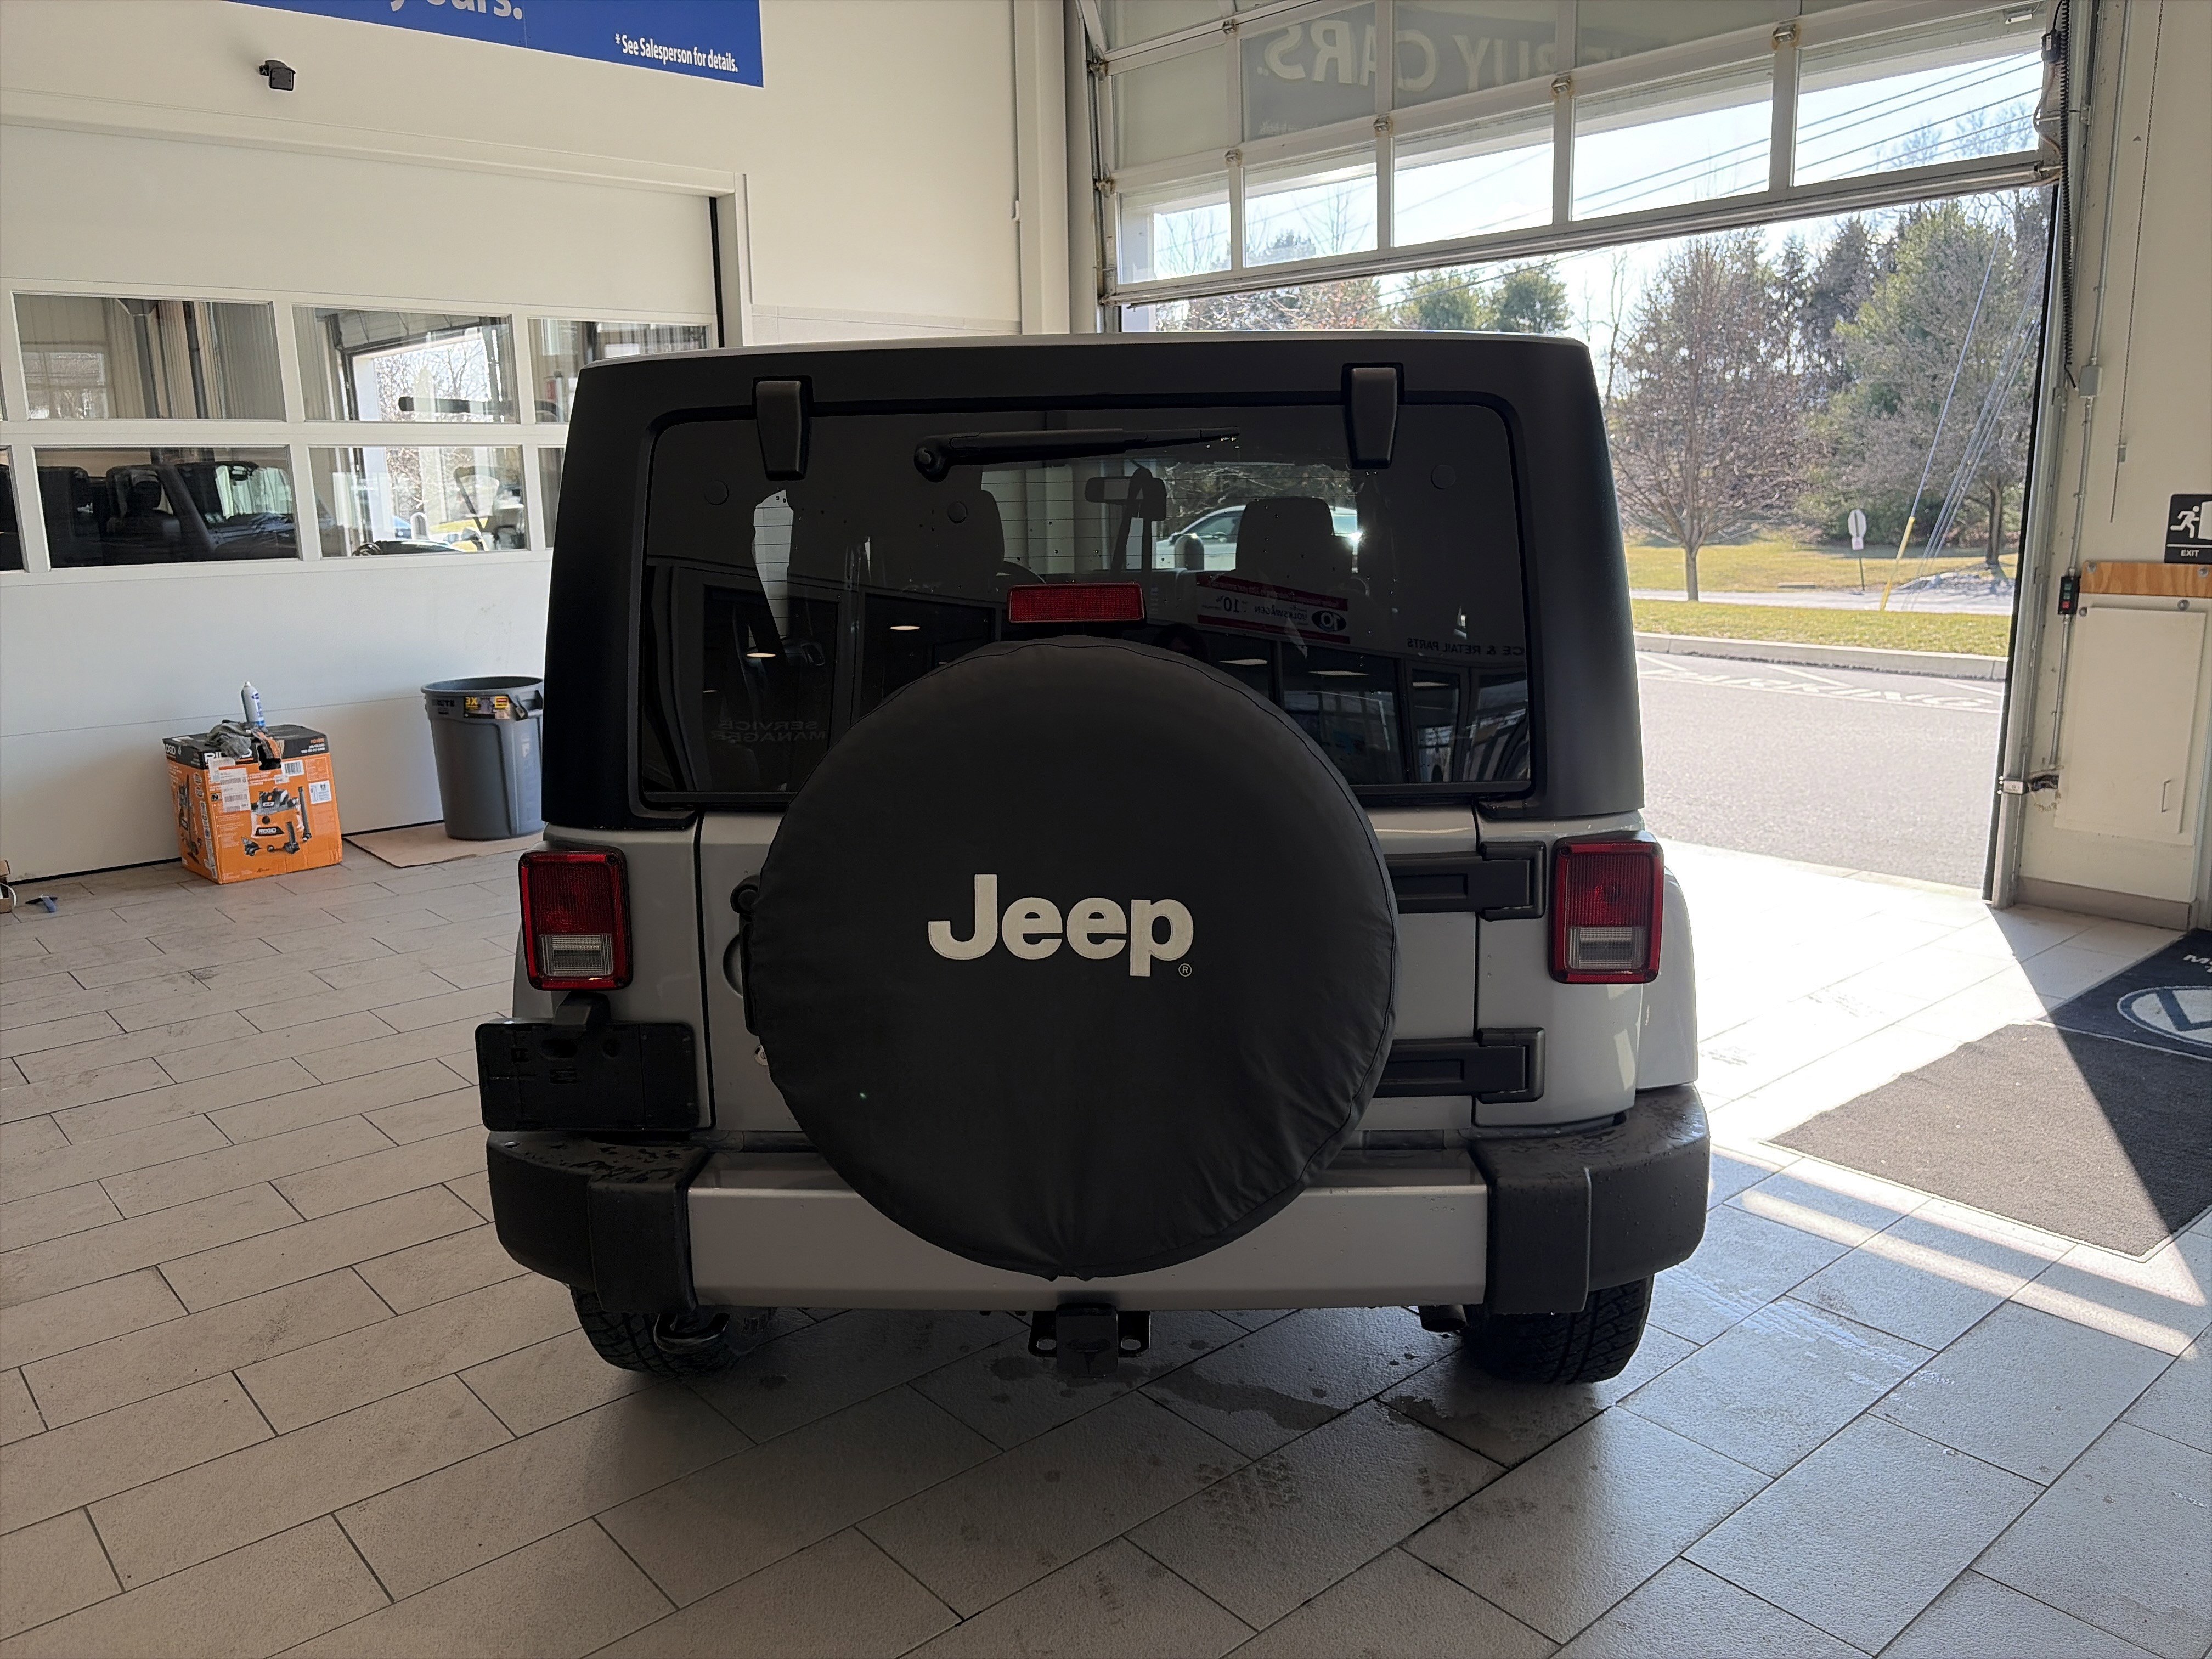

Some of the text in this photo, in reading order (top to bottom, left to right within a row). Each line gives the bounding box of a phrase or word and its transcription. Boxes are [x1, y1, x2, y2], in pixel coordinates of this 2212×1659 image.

[640, 37, 693, 65] Salesperson
[693, 46, 706, 66] for
[708, 49, 738, 72] details.
[928, 874, 1194, 977] Jeep
